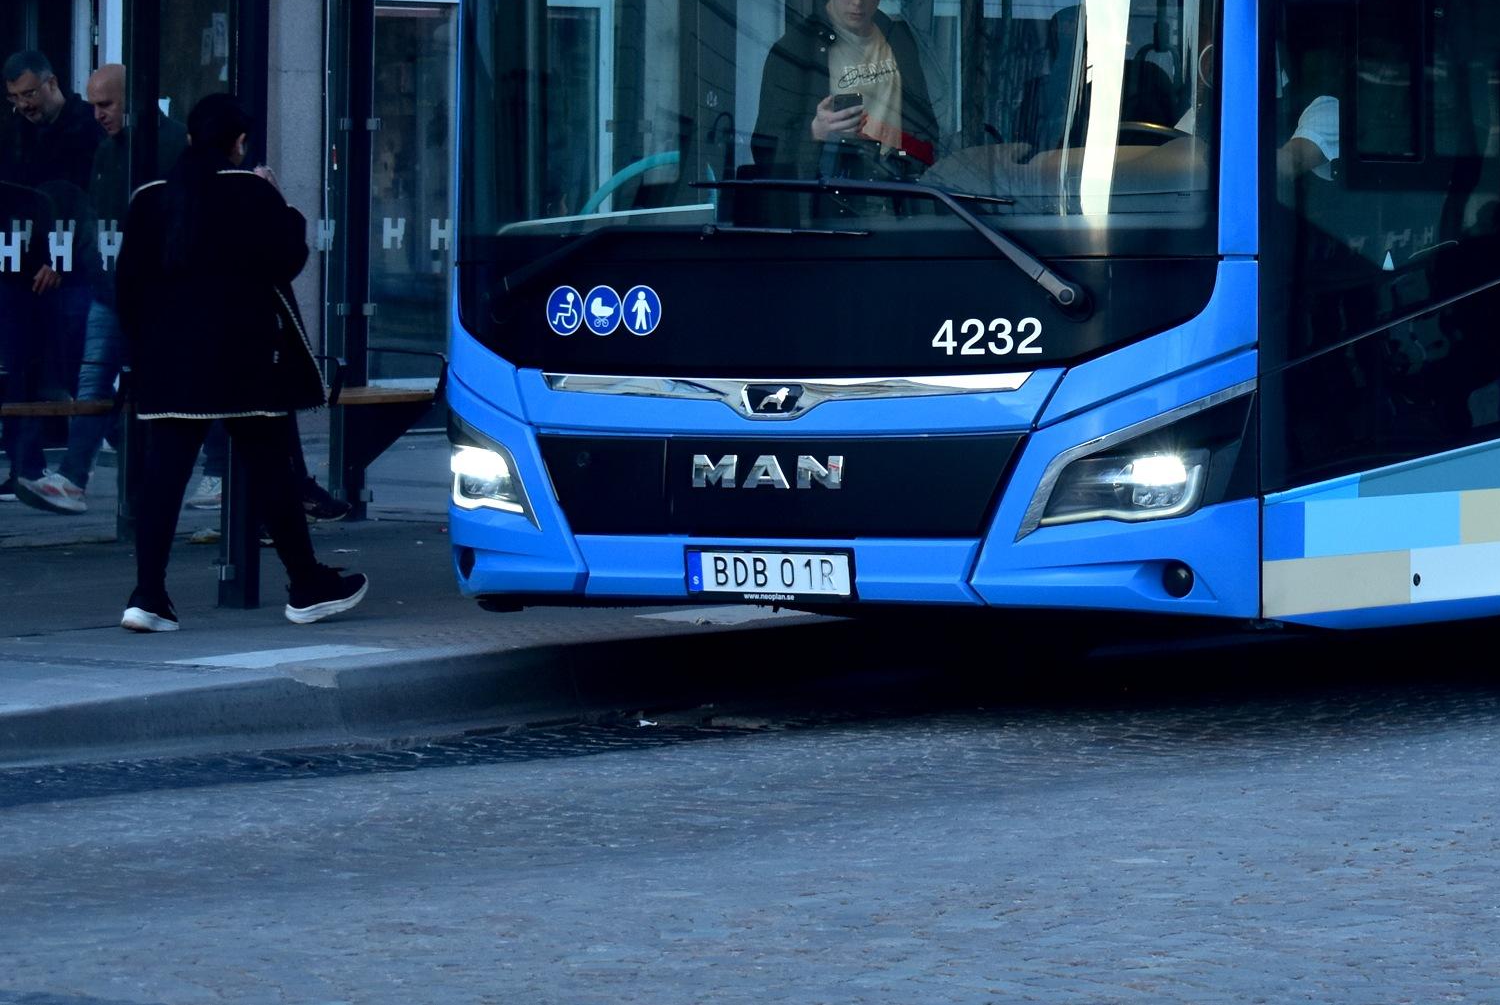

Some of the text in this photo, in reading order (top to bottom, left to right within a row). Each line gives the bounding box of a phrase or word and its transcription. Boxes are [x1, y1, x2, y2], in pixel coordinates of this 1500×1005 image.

[931, 317, 1044, 355] 4232
[692, 454, 844, 490] MAN
[692, 575, 700, 585] S
[713, 556, 768, 588] BDB
[743, 592, 795, 601] www.neoplan.se
